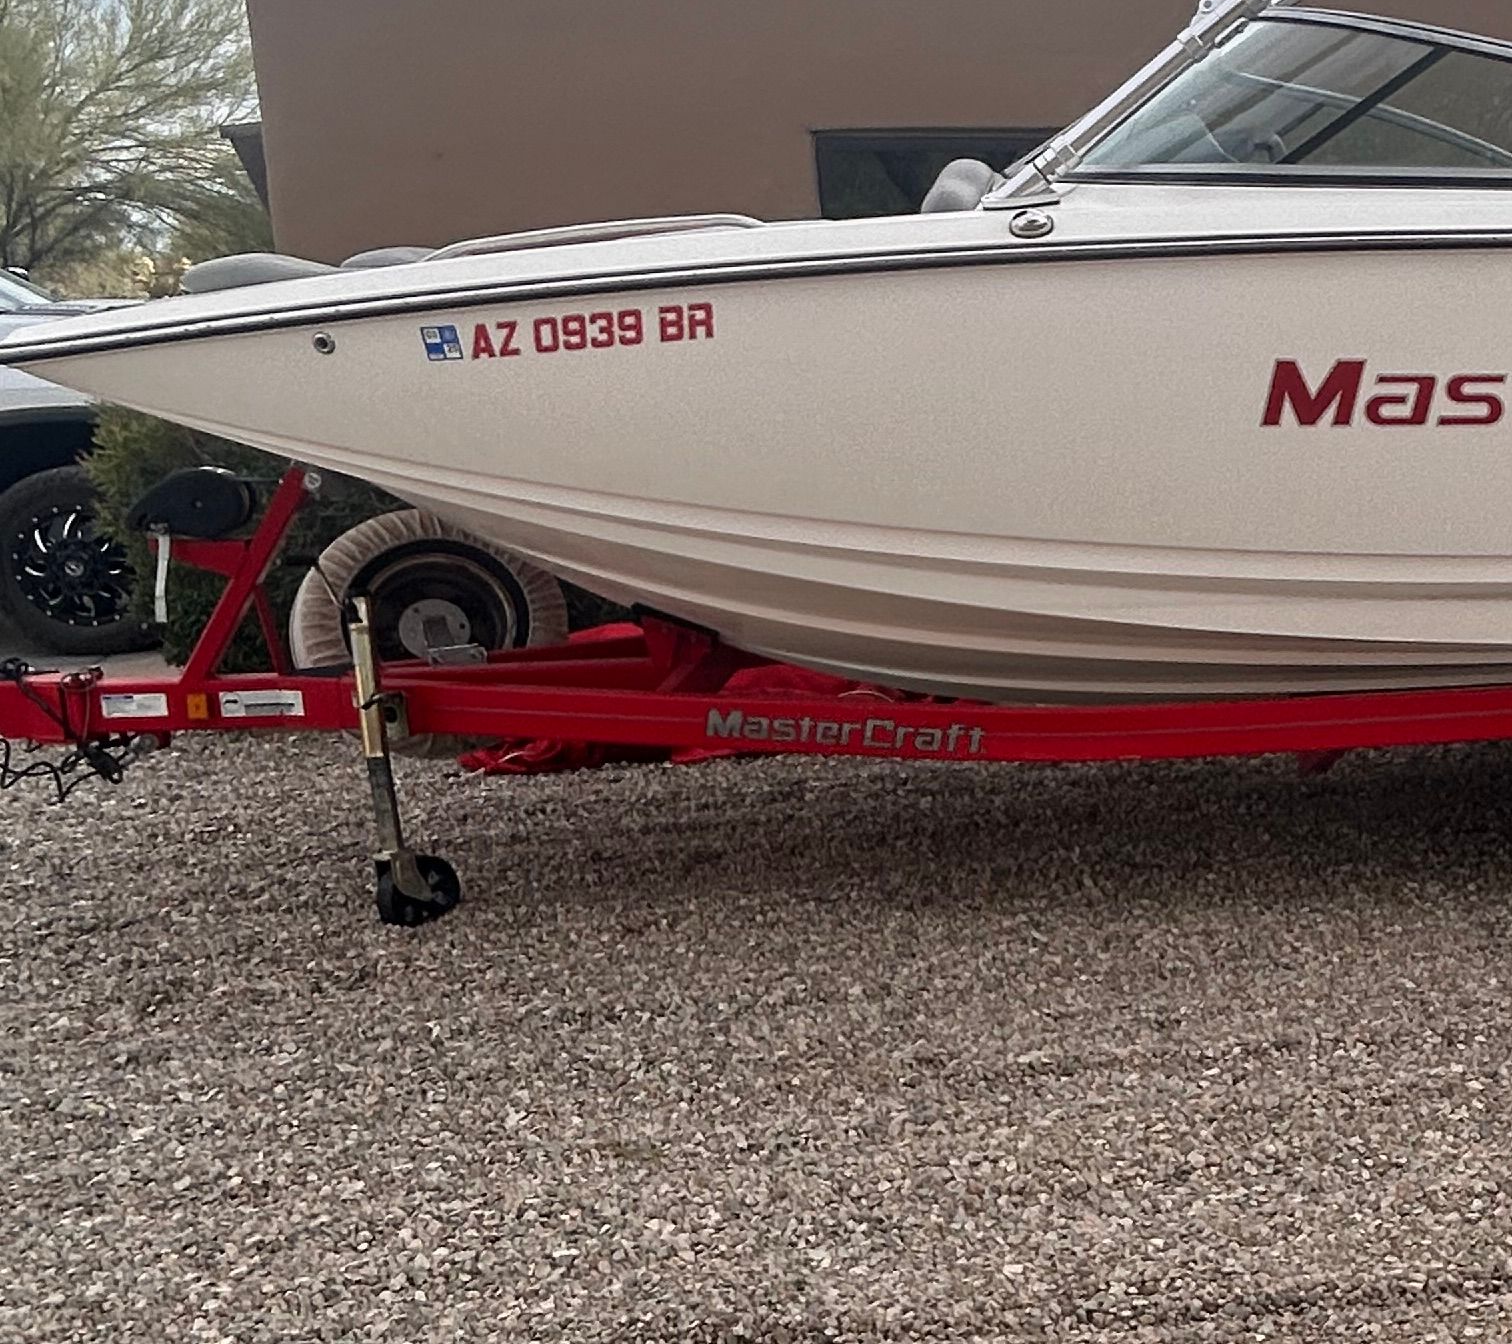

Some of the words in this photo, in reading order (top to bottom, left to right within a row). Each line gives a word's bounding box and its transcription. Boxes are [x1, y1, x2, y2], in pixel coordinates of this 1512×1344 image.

[471, 321, 520, 360] AZ
[533, 309, 644, 354] 0939
[658, 302, 714, 342] BR
[706, 708, 986, 754] MasterCraft
